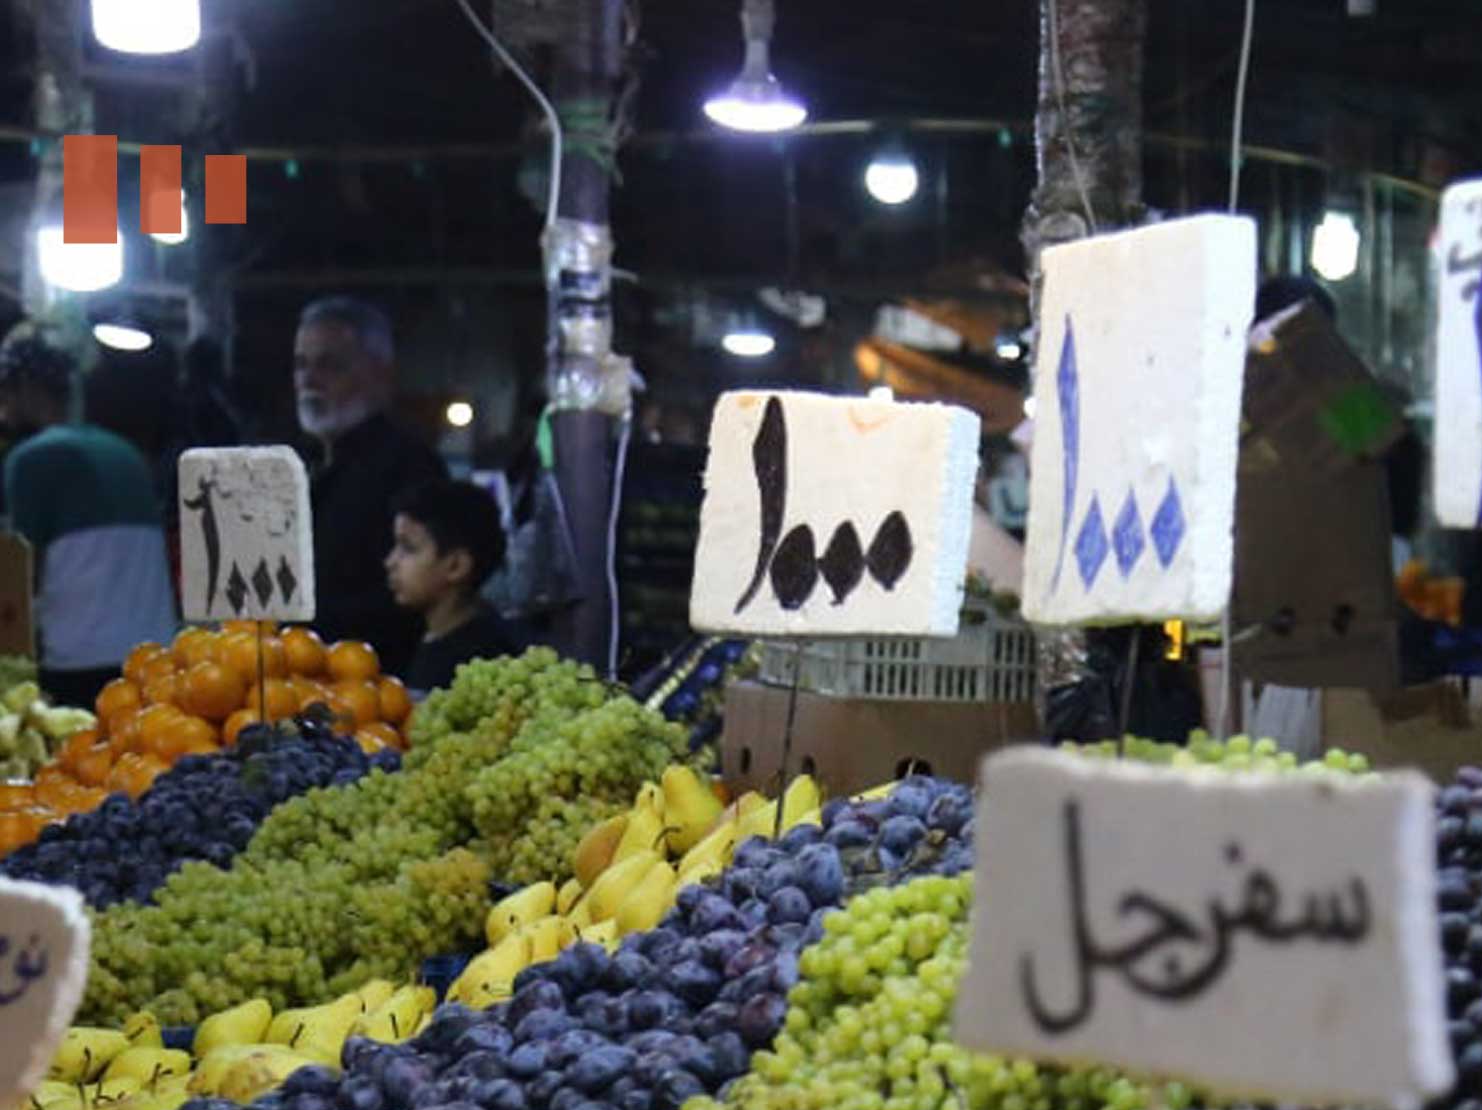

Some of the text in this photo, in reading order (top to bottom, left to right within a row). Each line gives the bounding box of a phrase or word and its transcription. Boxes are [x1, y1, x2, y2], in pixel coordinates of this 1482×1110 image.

[202, 477, 298, 617] ١٠٠٠
[733, 395, 914, 615] ١٠٠٠
[1044, 312, 1186, 600] ١٠٠٠
[1019, 792, 1374, 1036] سفرجل
